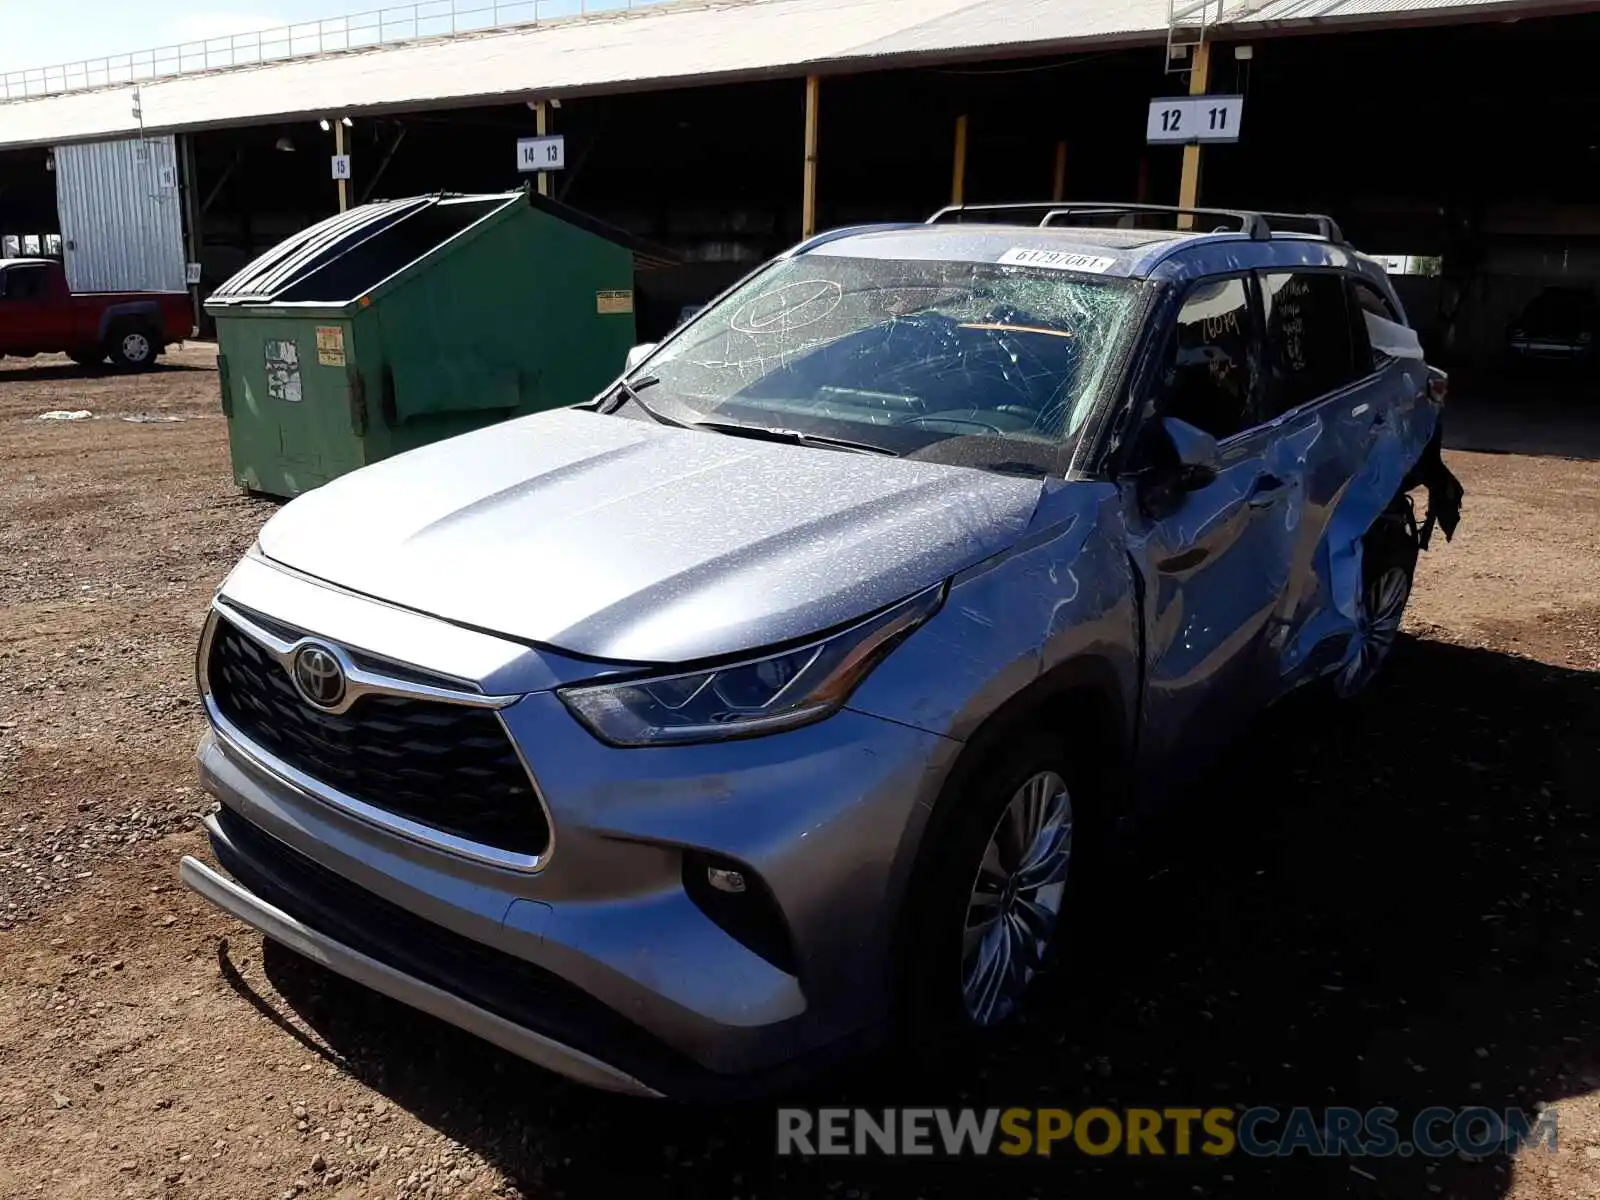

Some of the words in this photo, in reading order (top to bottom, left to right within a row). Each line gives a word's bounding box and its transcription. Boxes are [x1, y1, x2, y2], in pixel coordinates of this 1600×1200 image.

[1161, 109, 1182, 131] 12
[1208, 107, 1227, 130] 11
[523, 147, 534, 163] 14
[546, 145, 558, 161] 13
[336, 160, 346, 174] 15
